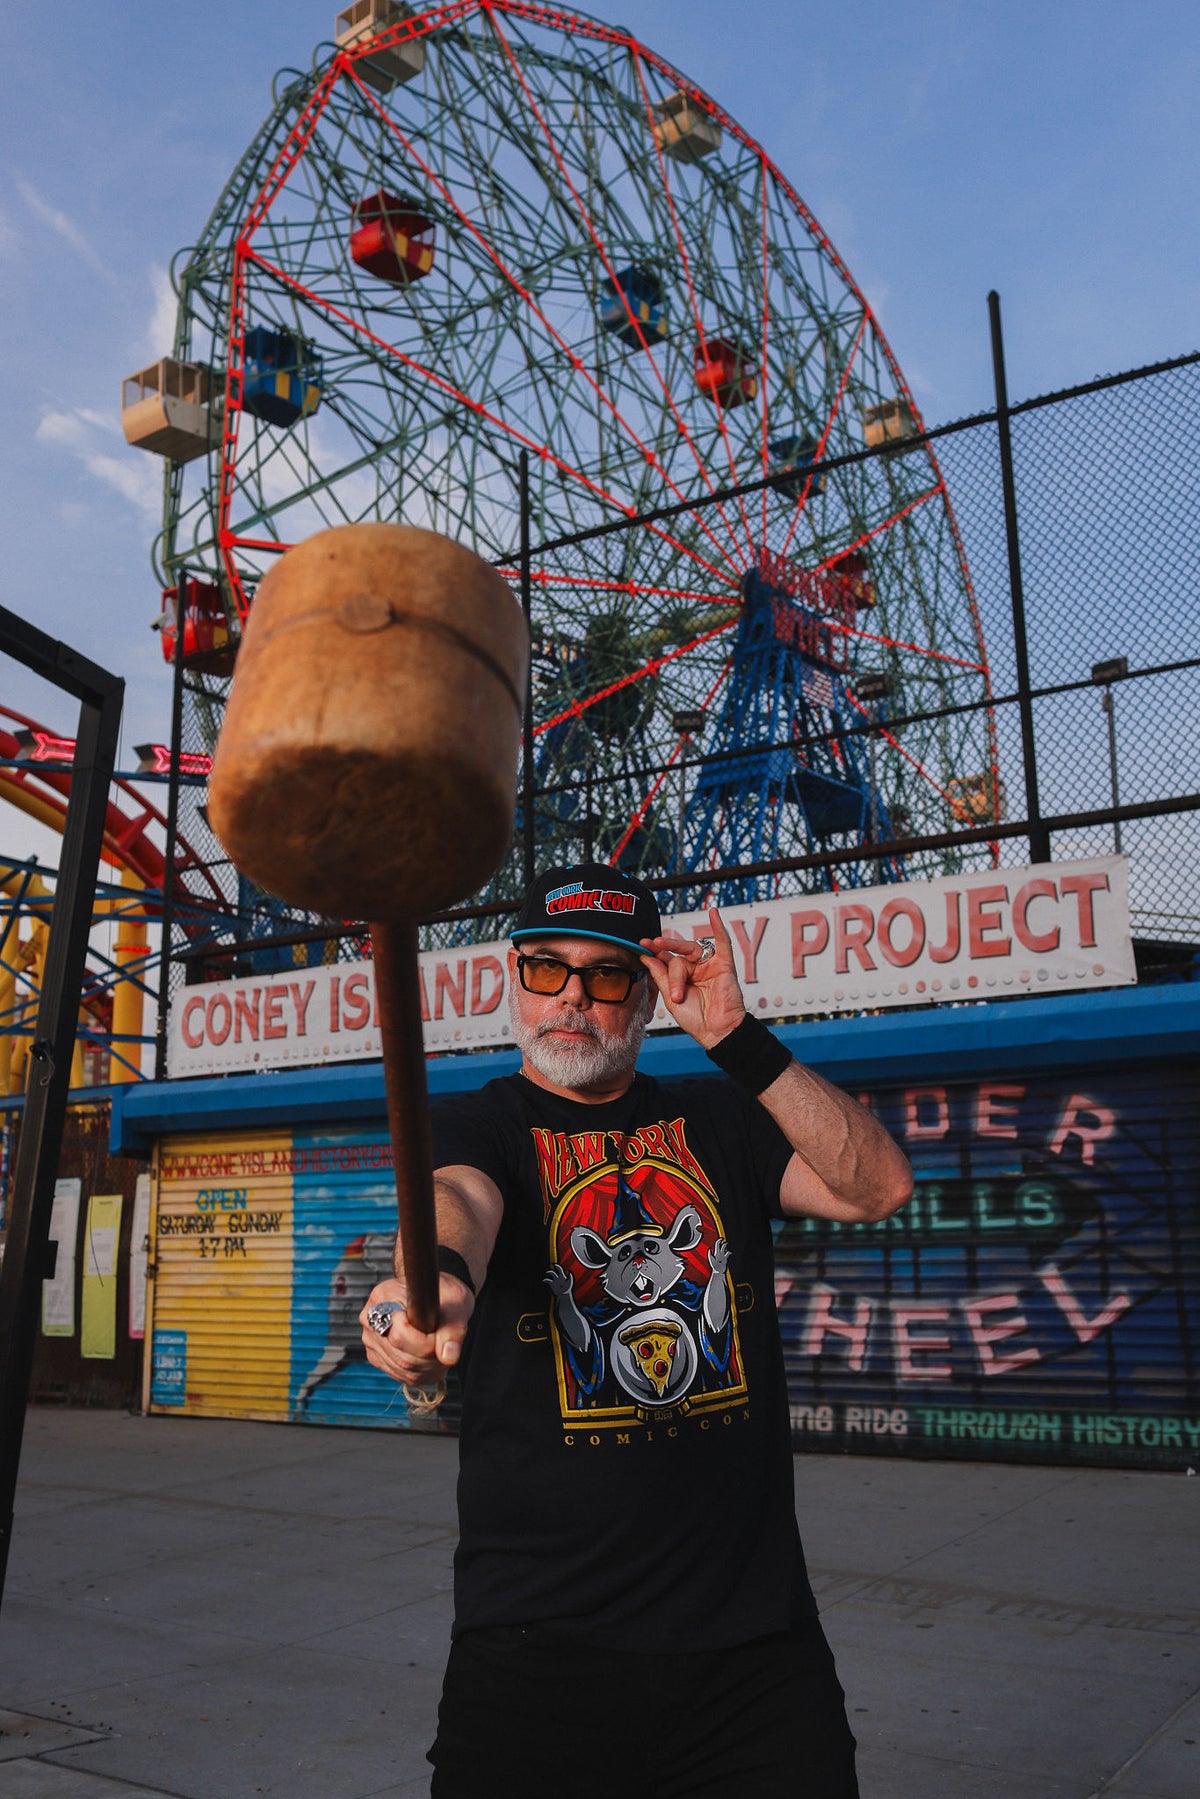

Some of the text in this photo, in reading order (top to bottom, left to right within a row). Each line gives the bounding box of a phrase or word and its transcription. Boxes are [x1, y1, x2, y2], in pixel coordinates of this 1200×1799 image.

[547, 883, 582, 903] NEW YORK
[548, 891, 636, 914] COMIC CON
[182, 979, 315, 1049] CONEY
[791, 873, 1109, 979] PROJECT
[530, 1117, 720, 1225] NEW YORK
[196, 1188, 248, 1211] OPEN
[160, 1212, 283, 1235] SATURDAY SUNDAY
[225, 1236, 247, 1258] PM
[563, 1409, 750, 1447] COMIC CON
[845, 1408, 909, 1436] RIDE
[917, 1409, 1061, 1442] THROUGH
[1071, 1415, 1200, 1448] HISTORY
